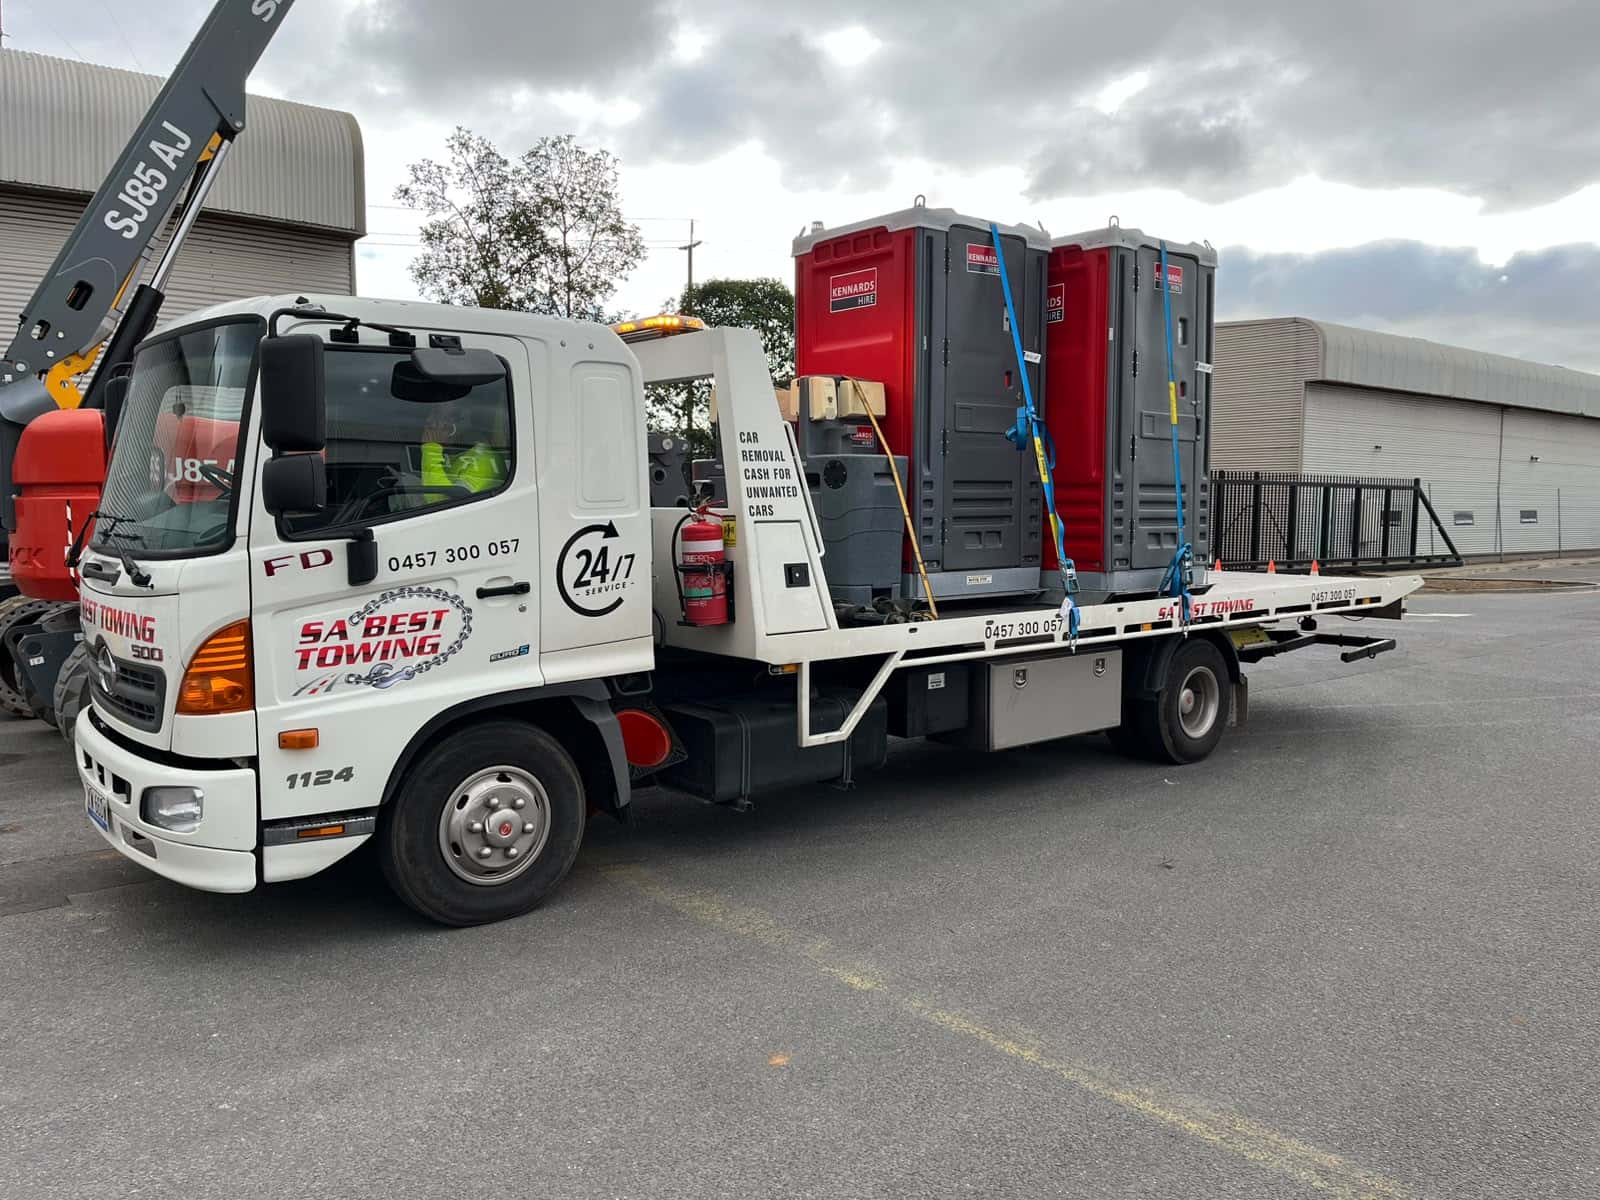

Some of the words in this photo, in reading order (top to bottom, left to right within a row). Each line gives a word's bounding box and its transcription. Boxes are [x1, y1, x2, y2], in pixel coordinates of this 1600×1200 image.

[104, 161, 168, 239] SJ85
[149, 120, 191, 171] AJ
[968, 253, 999, 264] KENNARD
[832, 280, 875, 297] KENNARDS
[858, 294, 874, 305] HIRE
[740, 431, 759, 444] CAR
[742, 449, 786, 462] REMOVAL
[744, 468, 770, 481] CASH
[774, 467, 791, 480] FOR
[747, 485, 798, 499] UNWANTED
[749, 504, 774, 517] CARS
[388, 551, 437, 572] 0457
[445, 544, 480, 563] 300
[488, 538, 520, 556] 057
[573, 545, 635, 589] 24/7
[585, 581, 627, 596] SERVICE
[1311, 591, 1328, 602] 0457
[1330, 590, 1342, 601] 300
[1344, 588, 1356, 599] 057
[1158, 606, 1174, 621] SA
[1211, 598, 1254, 615] TOWING
[100, 604, 156, 644] TOWING
[299, 619, 348, 645] SA
[362, 608, 450, 639] BEST
[985, 623, 1014, 640] 0457
[1018, 621, 1039, 636] 300
[1043, 619, 1064, 634] 057
[131, 644, 164, 662] 500
[294, 634, 442, 671] TOWING
[286, 766, 354, 790] 1124
